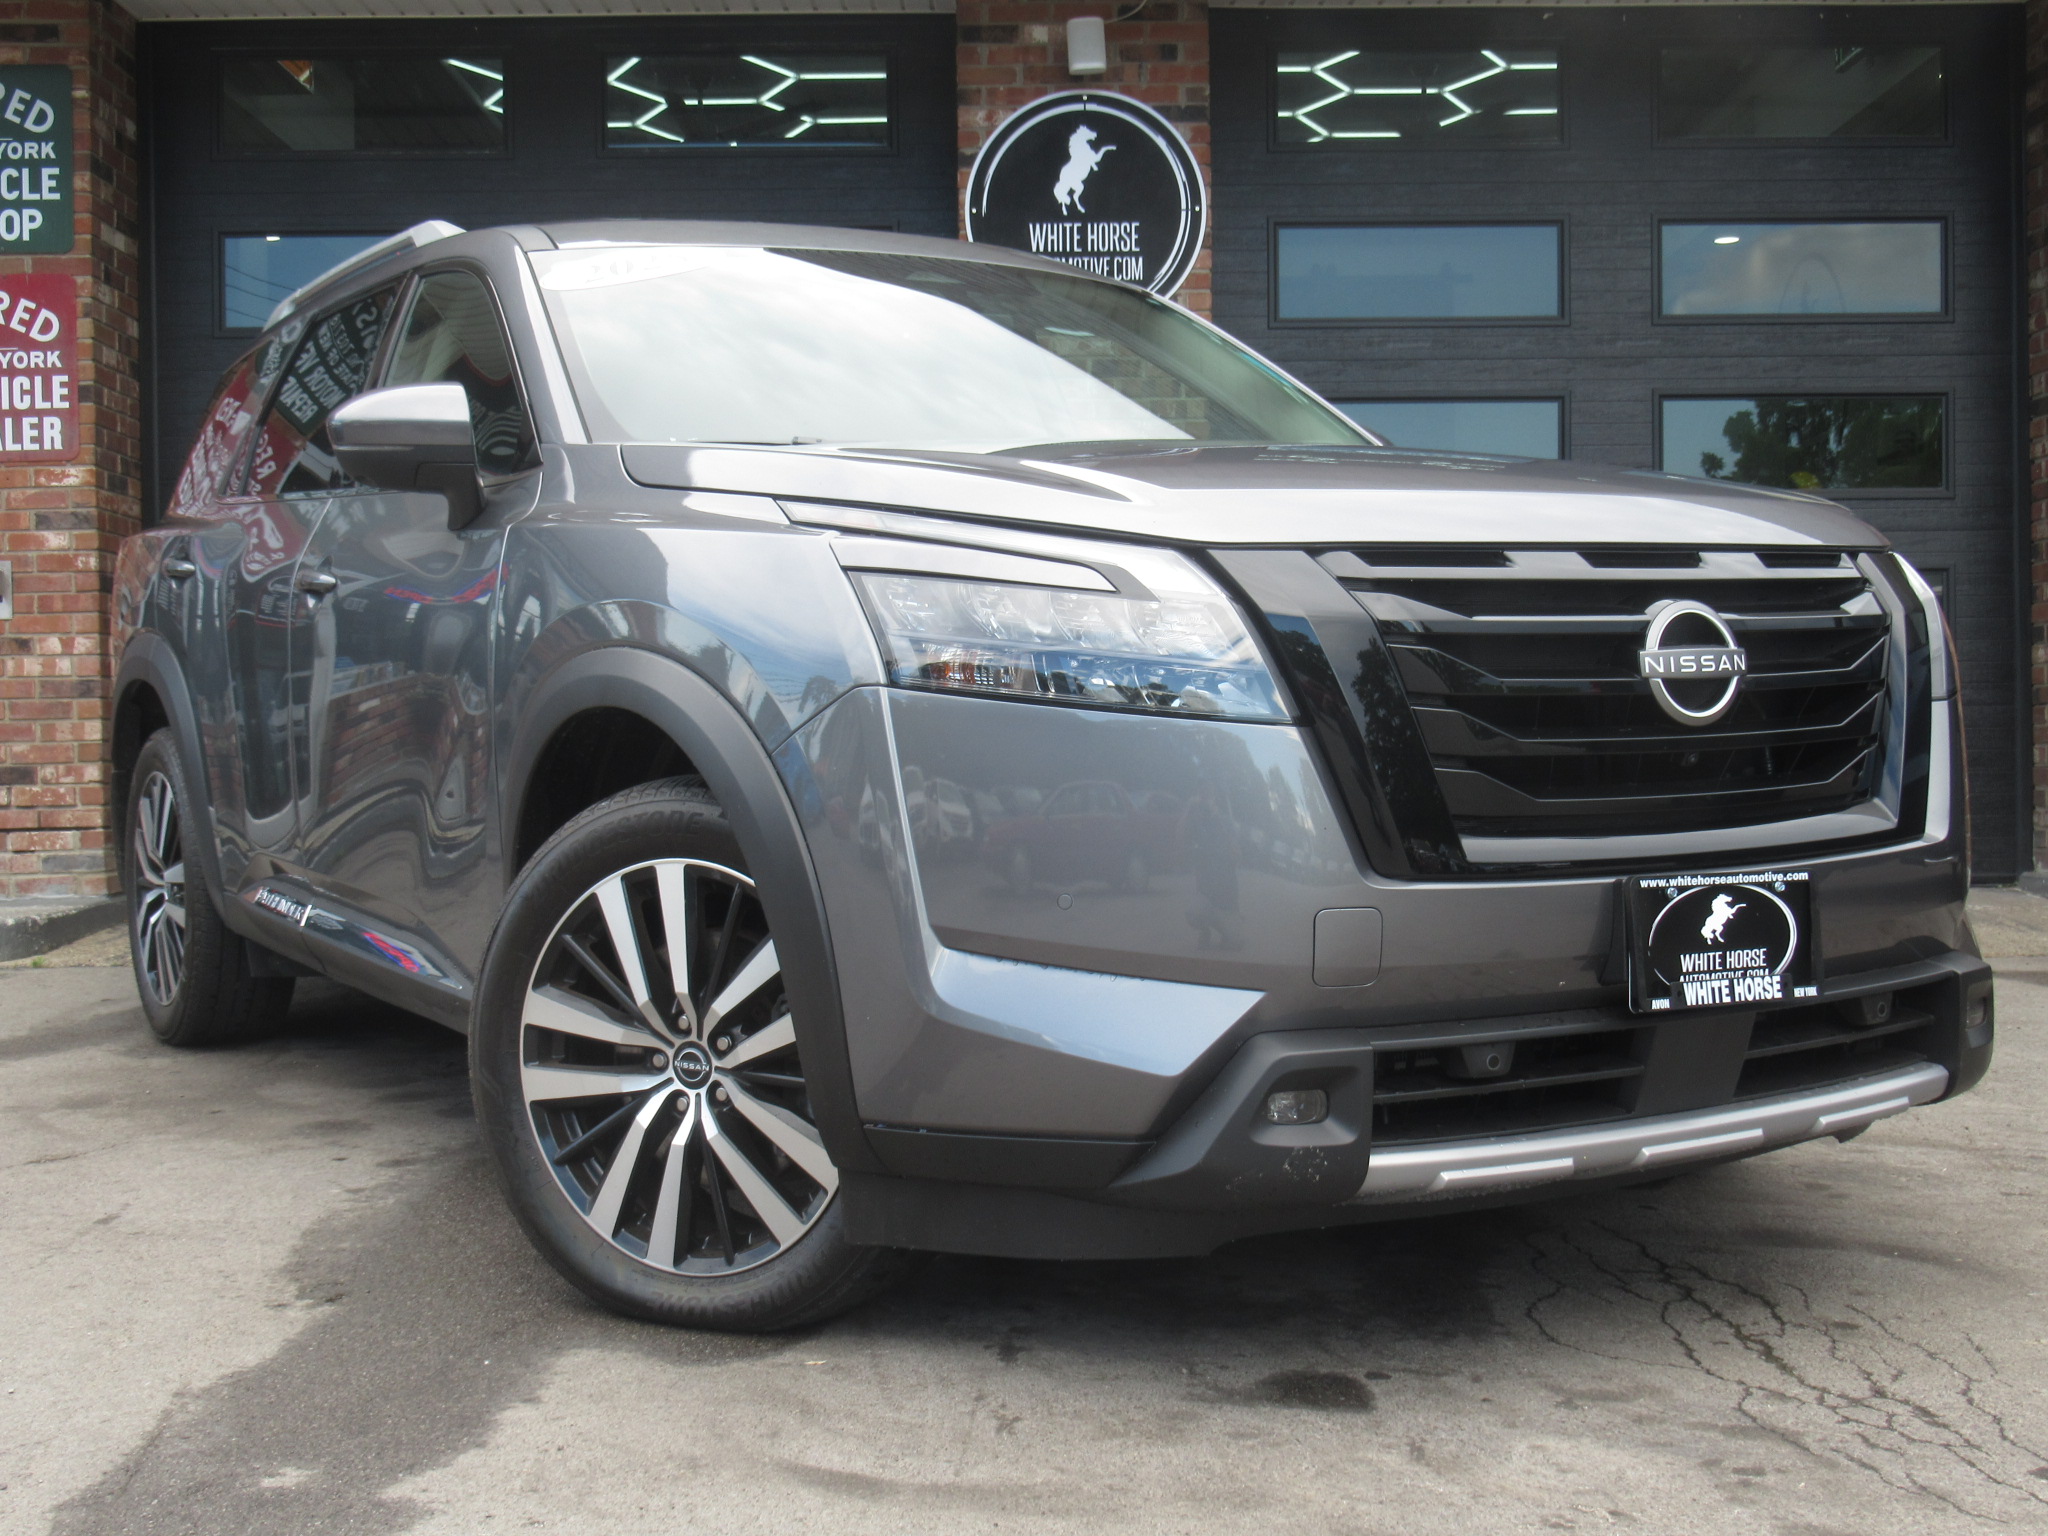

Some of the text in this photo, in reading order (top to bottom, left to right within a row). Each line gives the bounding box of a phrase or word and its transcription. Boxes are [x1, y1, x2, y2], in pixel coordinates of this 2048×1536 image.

[0, 167, 61, 201] CLE
[1028, 222, 1141, 253] WHITE HORSE
[1, 375, 70, 410] ICLE
[1644, 654, 1746, 673] NISSAN
[1640, 872, 1809, 888] www.whitehorseautomotive.com
[1680, 948, 1767, 973] WHITE HORSE
[1683, 975, 1783, 1006] WHITE HORSE
[1652, 999, 1670, 1010] AVON
[674, 1060, 710, 1072] NISSAN
